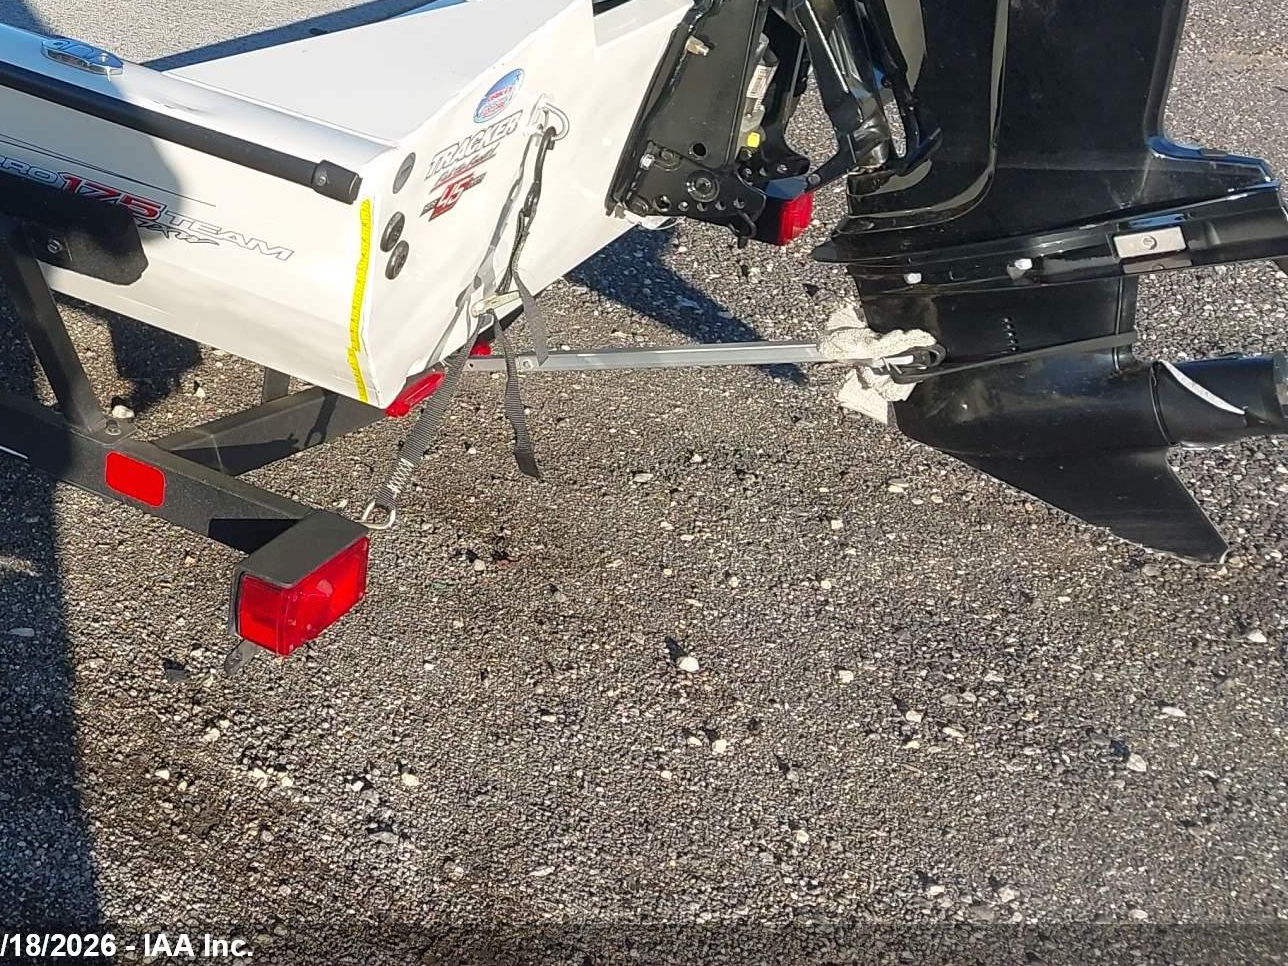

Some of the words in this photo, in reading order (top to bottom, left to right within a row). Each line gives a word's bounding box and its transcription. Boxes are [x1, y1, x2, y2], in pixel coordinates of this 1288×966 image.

[425, 110, 523, 181] TRACKER
[60, 172, 166, 220] 175
[165, 209, 295, 261] TEAM
